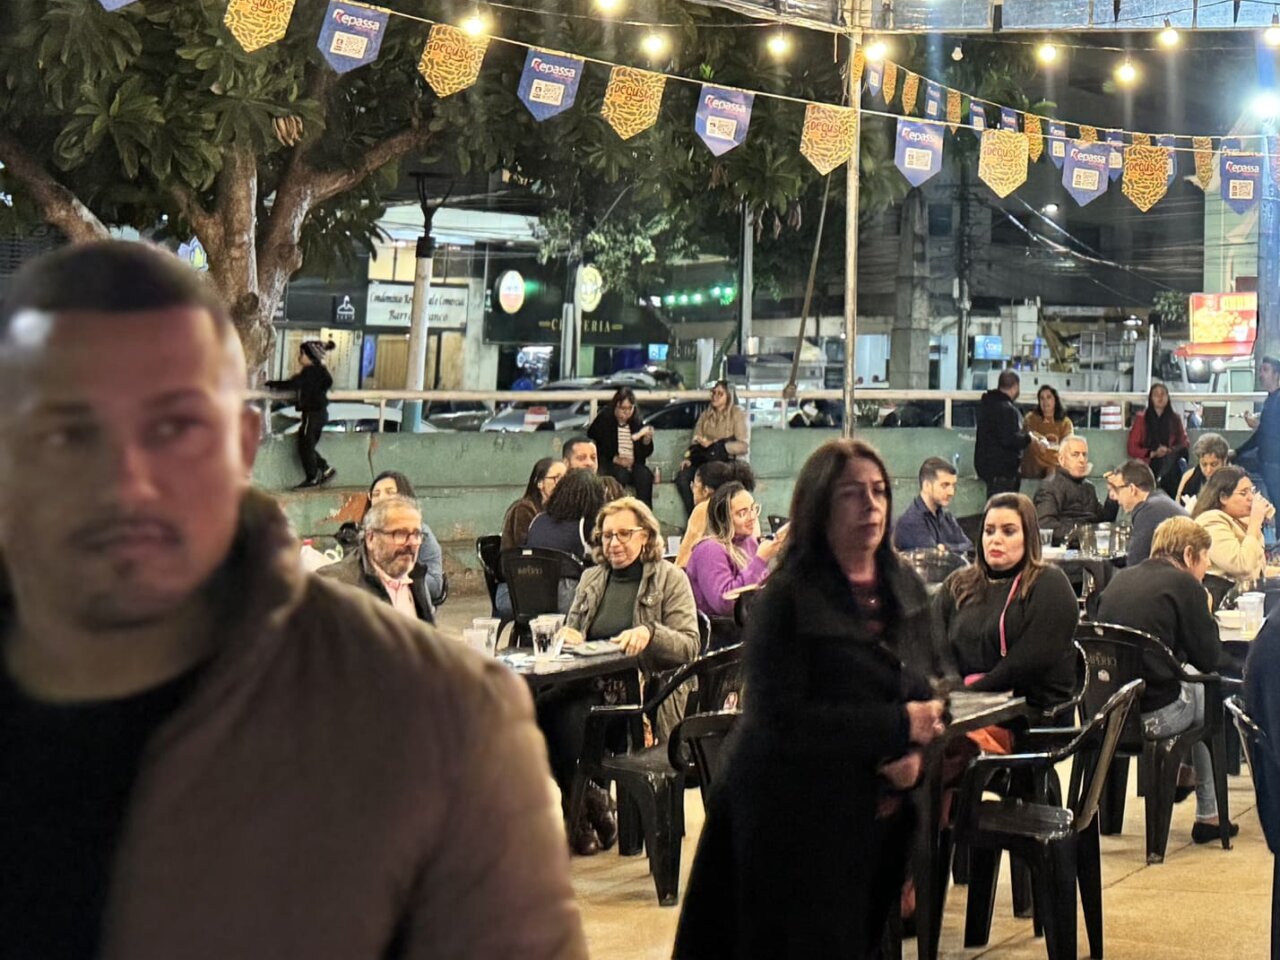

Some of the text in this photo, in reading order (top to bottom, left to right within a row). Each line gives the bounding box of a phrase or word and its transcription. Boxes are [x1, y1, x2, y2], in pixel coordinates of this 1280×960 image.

[333, 8, 380, 32] Repassa
[433, 42, 477, 62] Degusta
[531, 58, 576, 79] Repassa
[704, 94, 746, 114] Repassa
[1071, 148, 1106, 164] Repassa
[1226, 161, 1260, 174] Repassa
[551, 319, 611, 333] CERIA
